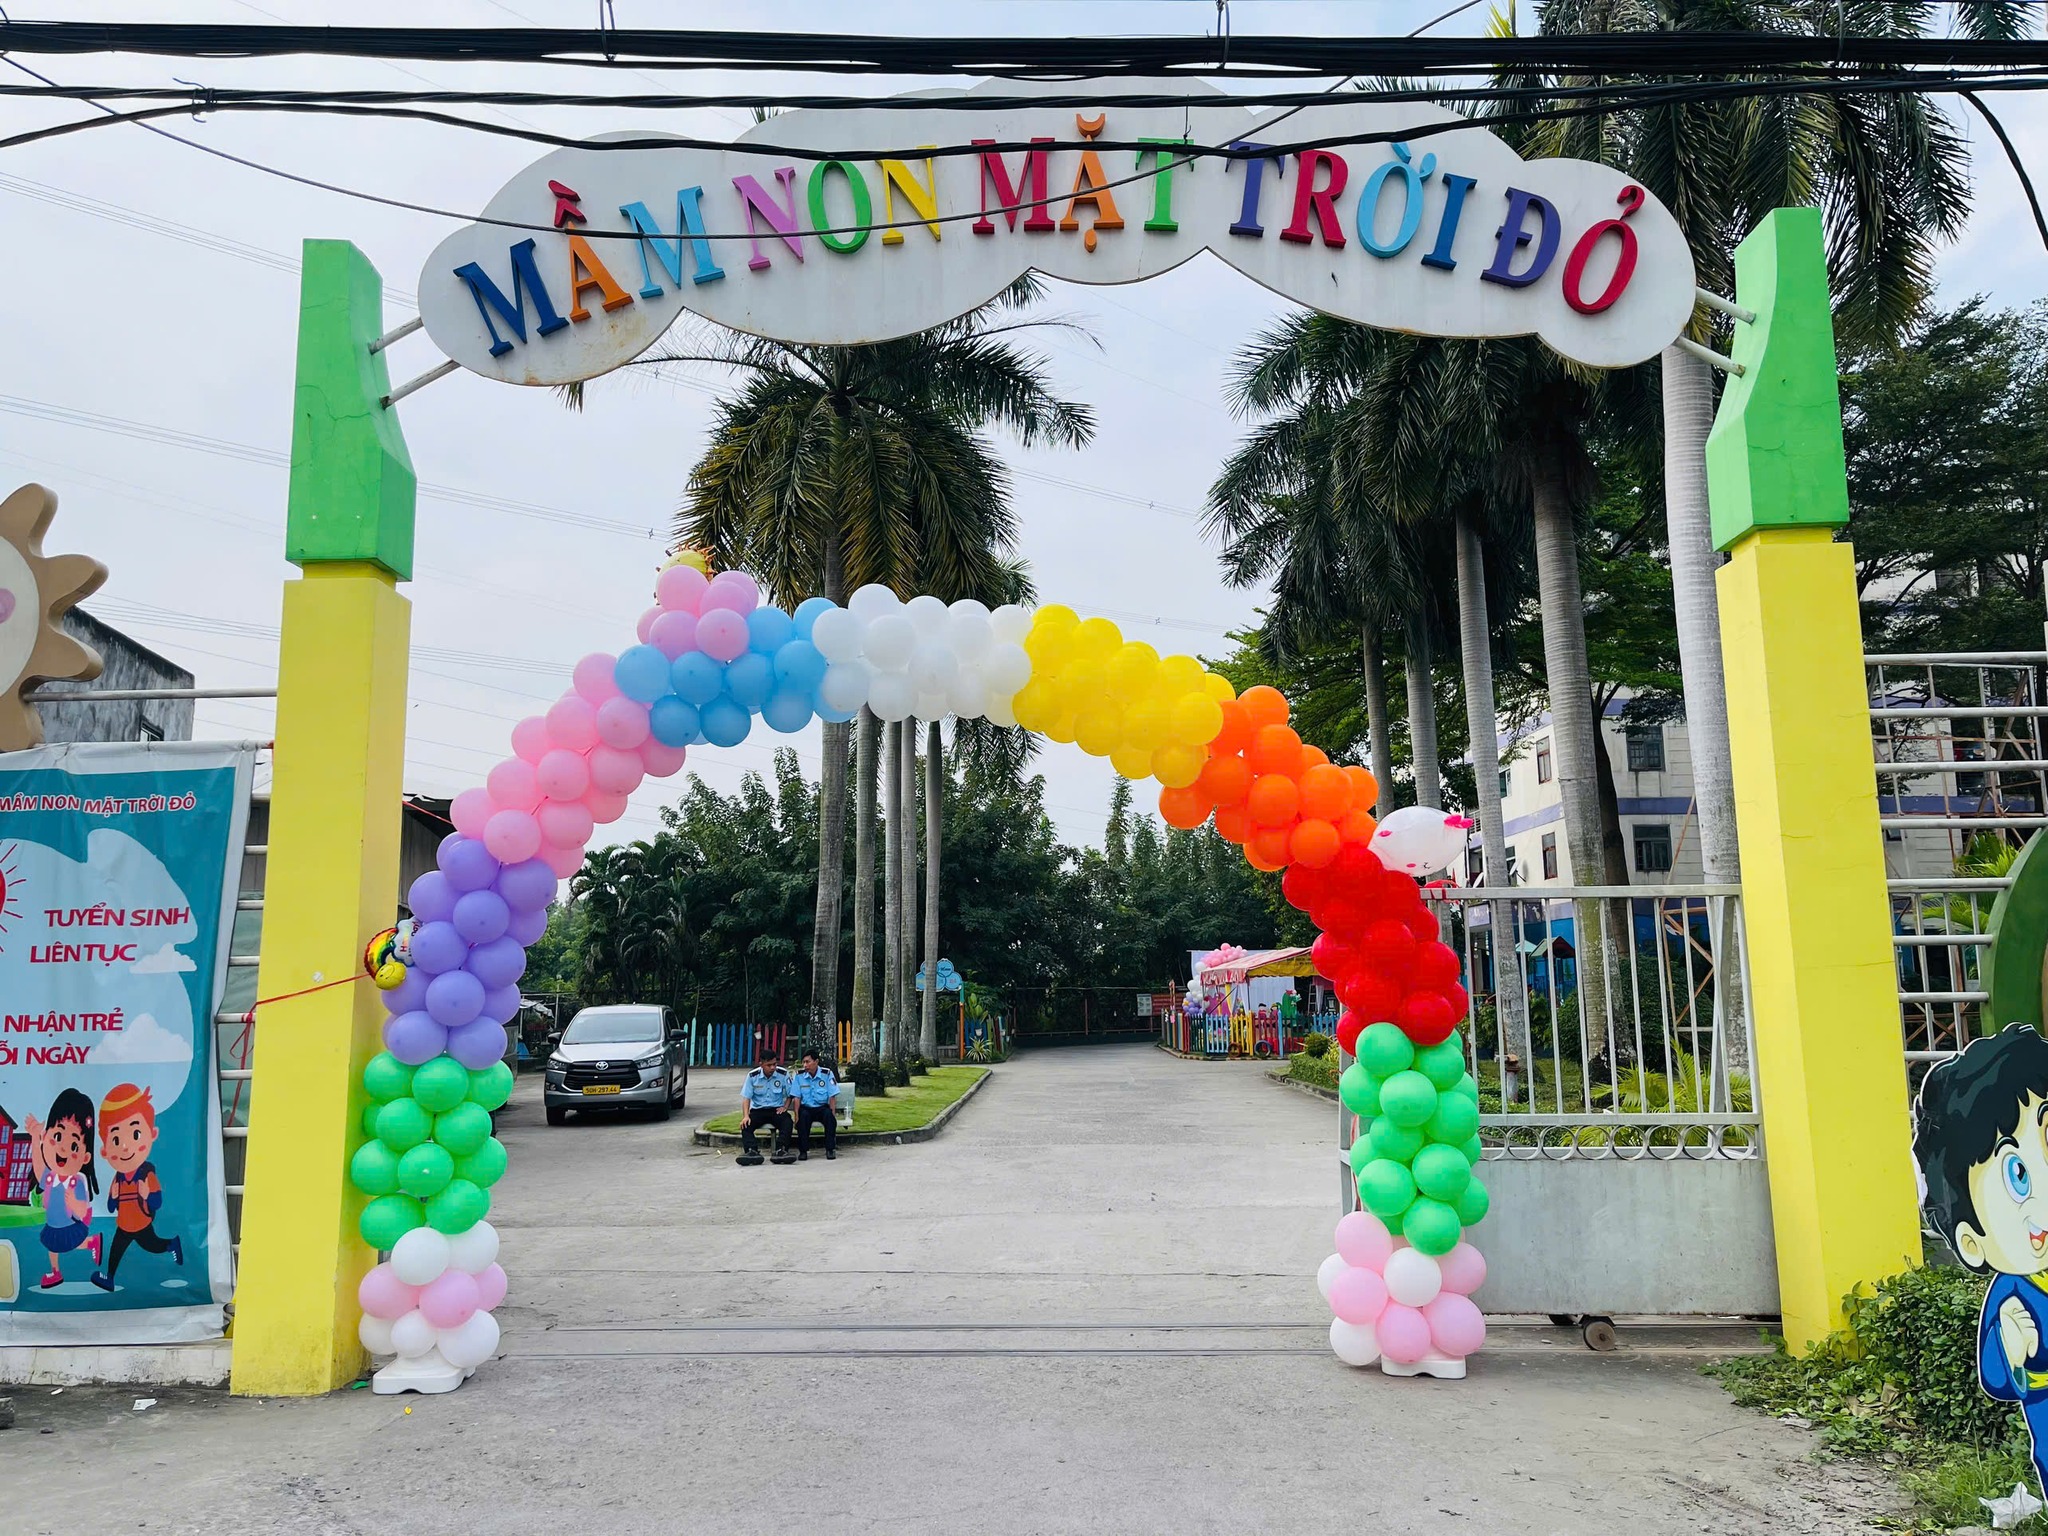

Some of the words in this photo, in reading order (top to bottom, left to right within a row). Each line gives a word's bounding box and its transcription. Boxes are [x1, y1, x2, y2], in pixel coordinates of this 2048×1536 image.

[453, 180, 725, 358] MẦM
[732, 145, 941, 270] NON
[971, 113, 1195, 253] MẶT
[1226, 140, 1477, 270] TRỜI
[1480, 185, 1645, 315] ĐỎ
[41, 795, 80, 811] NON
[83, 797, 124, 817] MẶT
[127, 795, 164, 813] TRỜI
[168, 791, 196, 811] ĐỎ
[44, 902, 125, 928] TUYỂN
[130, 907, 190, 927] SINH
[30, 941, 81, 963] LIÊN
[83, 944, 138, 966] TỤC
[4, 1010, 76, 1037] NHẬN
[79, 1007, 124, 1032] TRẺ
[25, 1043, 91, 1065] NGÀY
